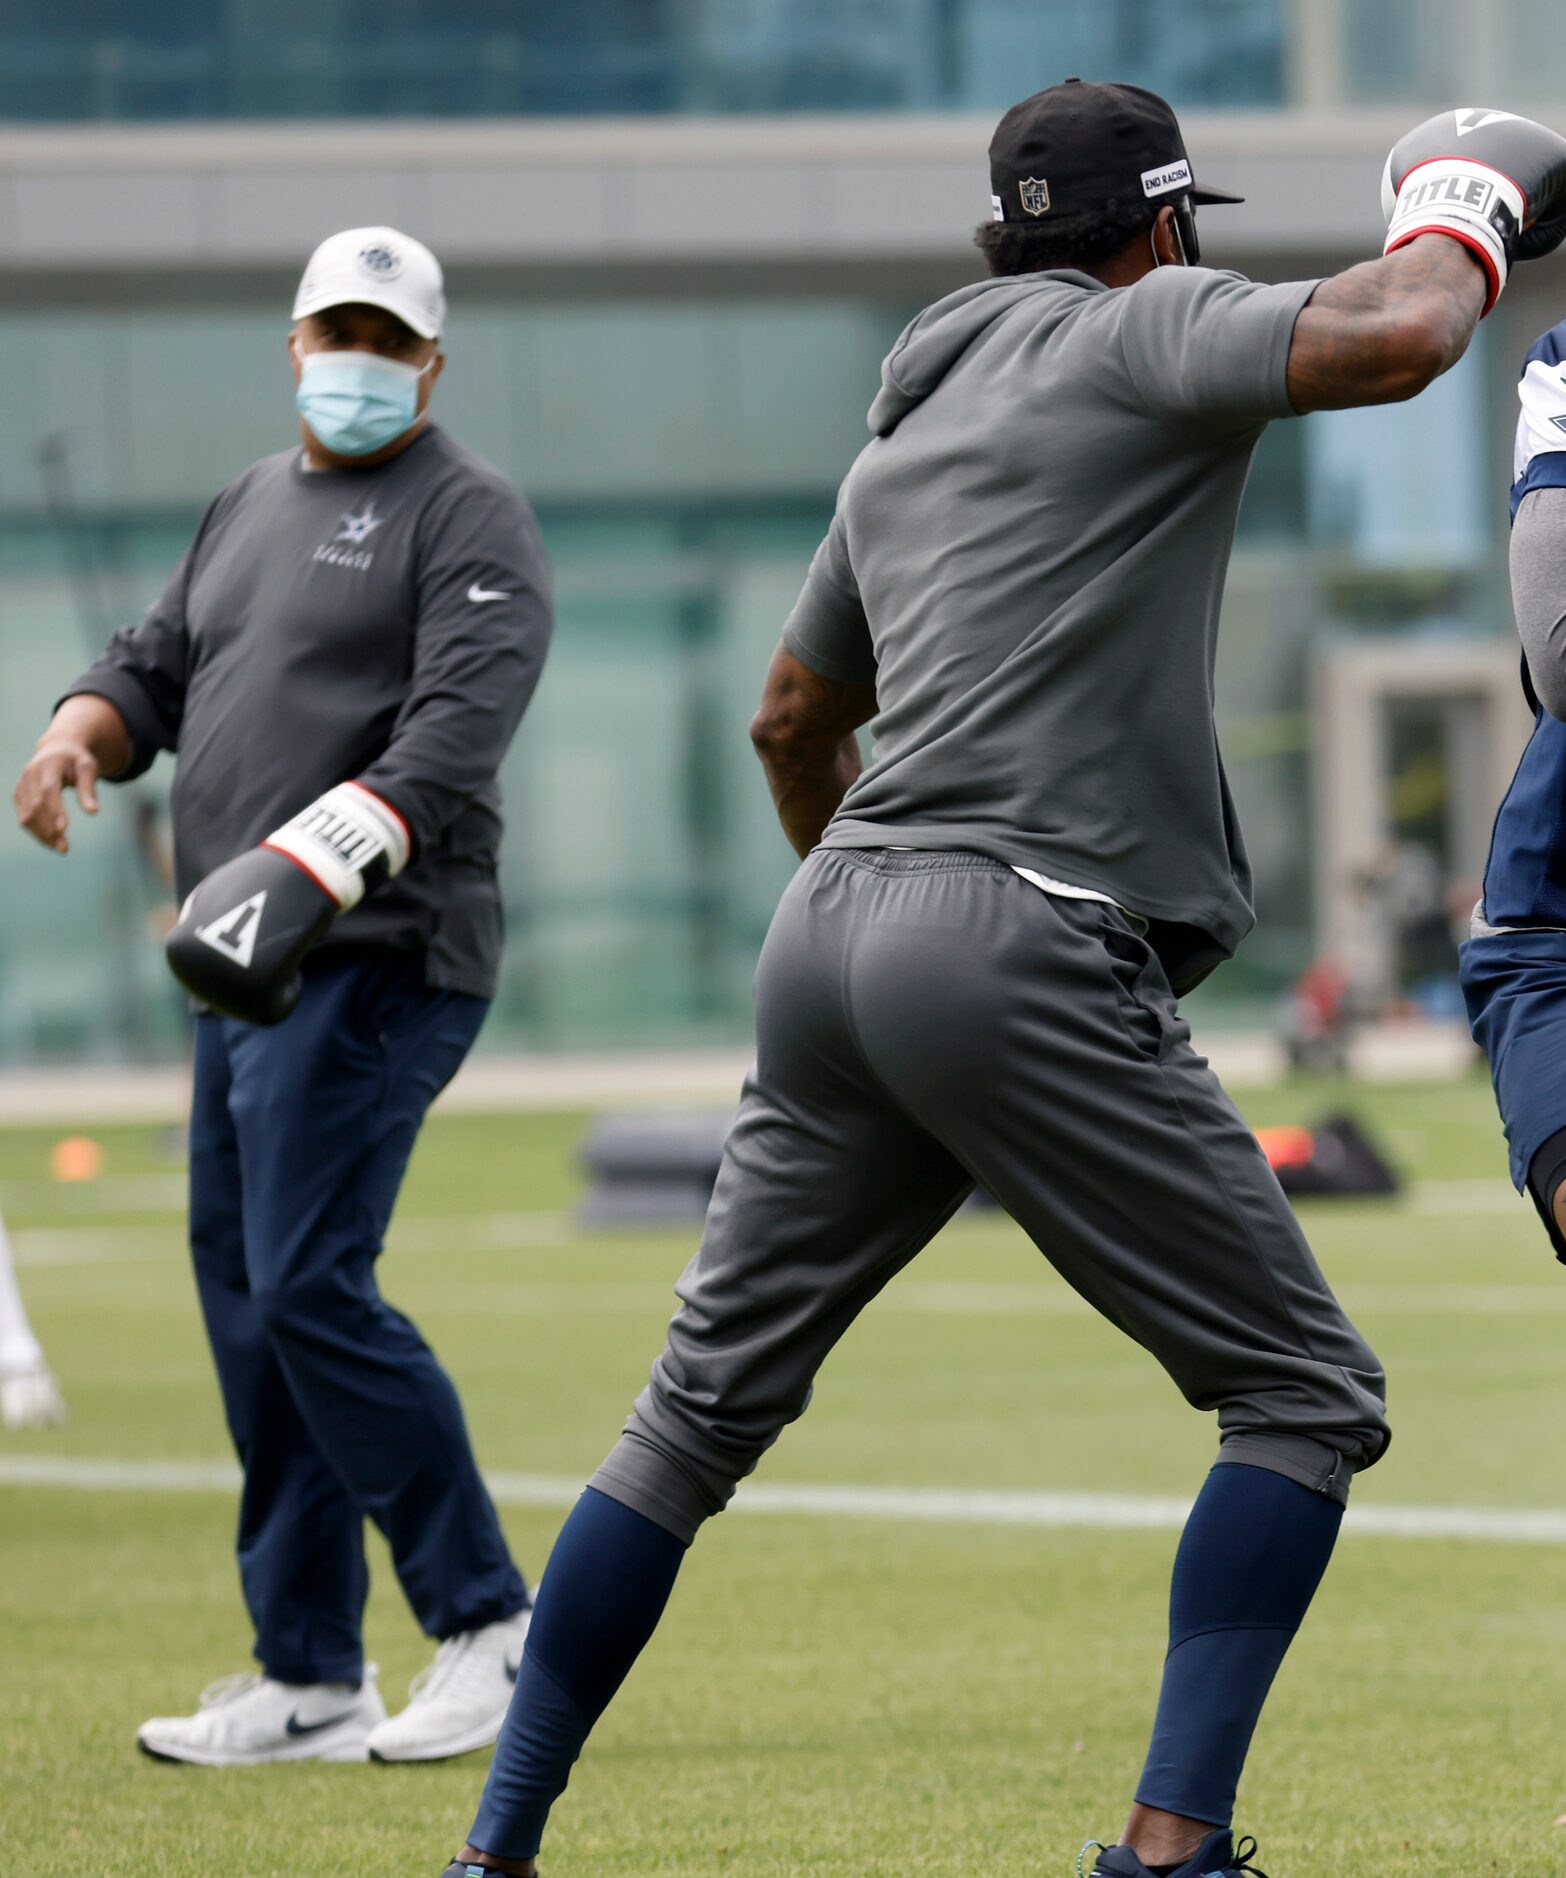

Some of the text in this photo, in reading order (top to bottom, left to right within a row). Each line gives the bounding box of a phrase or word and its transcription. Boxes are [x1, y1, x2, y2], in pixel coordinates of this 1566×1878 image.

[1145, 168, 1188, 190] END RACISM
[1025, 193, 1046, 210] NFL
[1403, 177, 1486, 212] TITLE
[219, 905, 257, 949] T
